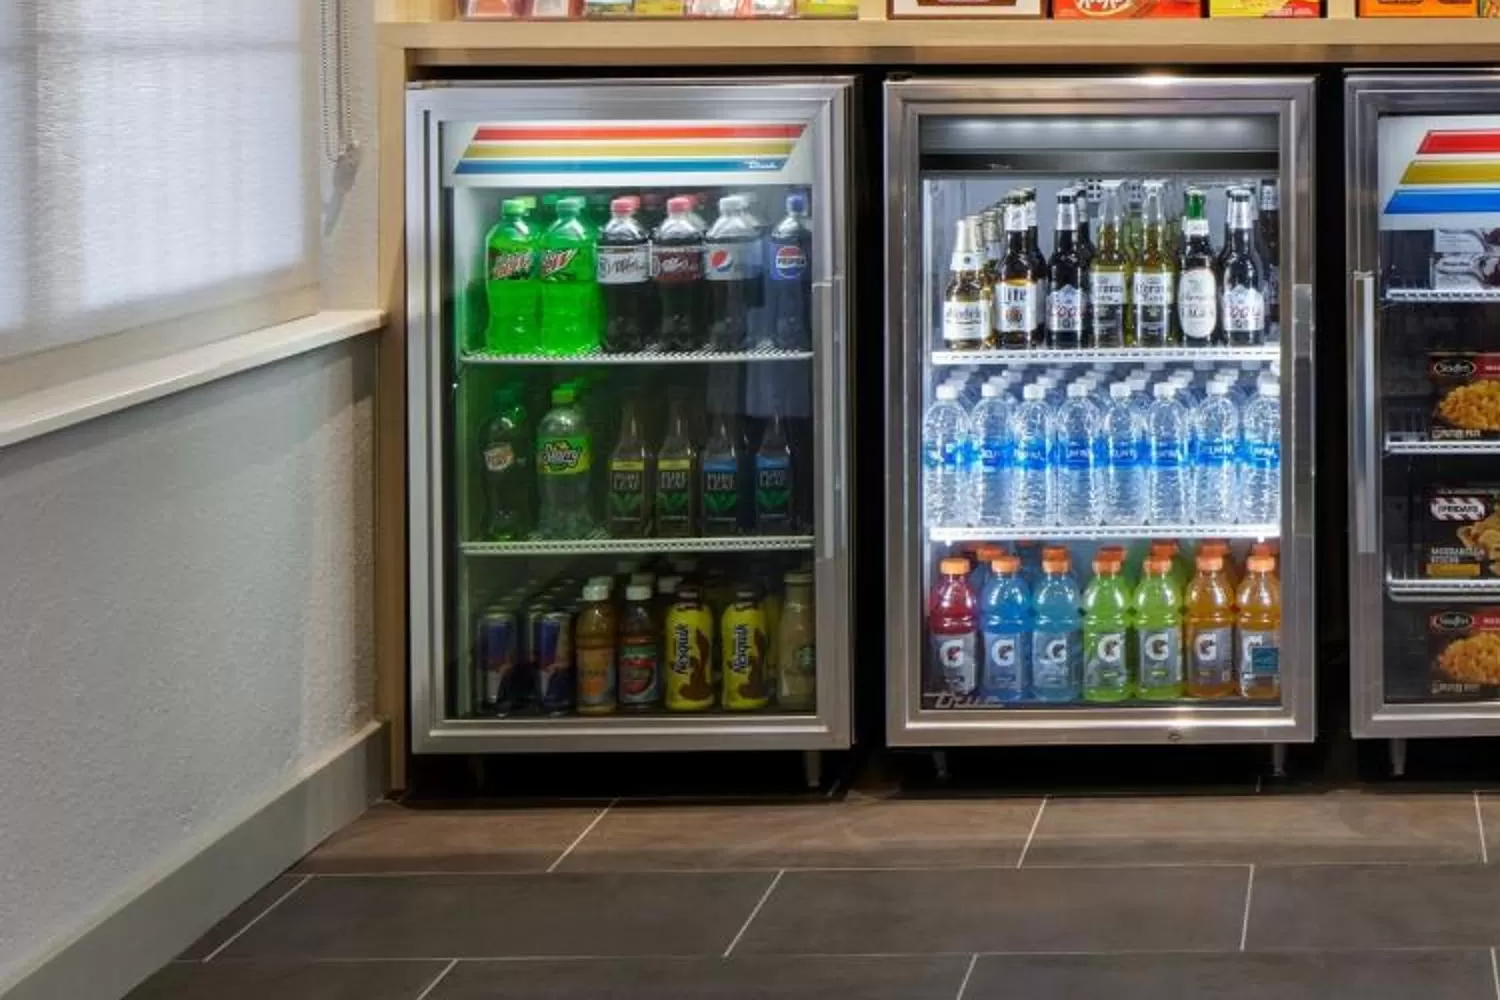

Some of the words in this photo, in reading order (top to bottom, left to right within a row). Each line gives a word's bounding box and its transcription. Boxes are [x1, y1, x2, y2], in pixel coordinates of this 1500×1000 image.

[939, 638, 964, 668] G
[991, 638, 1015, 667] G
[1145, 632, 1169, 661] G
[1194, 632, 1217, 661] G
